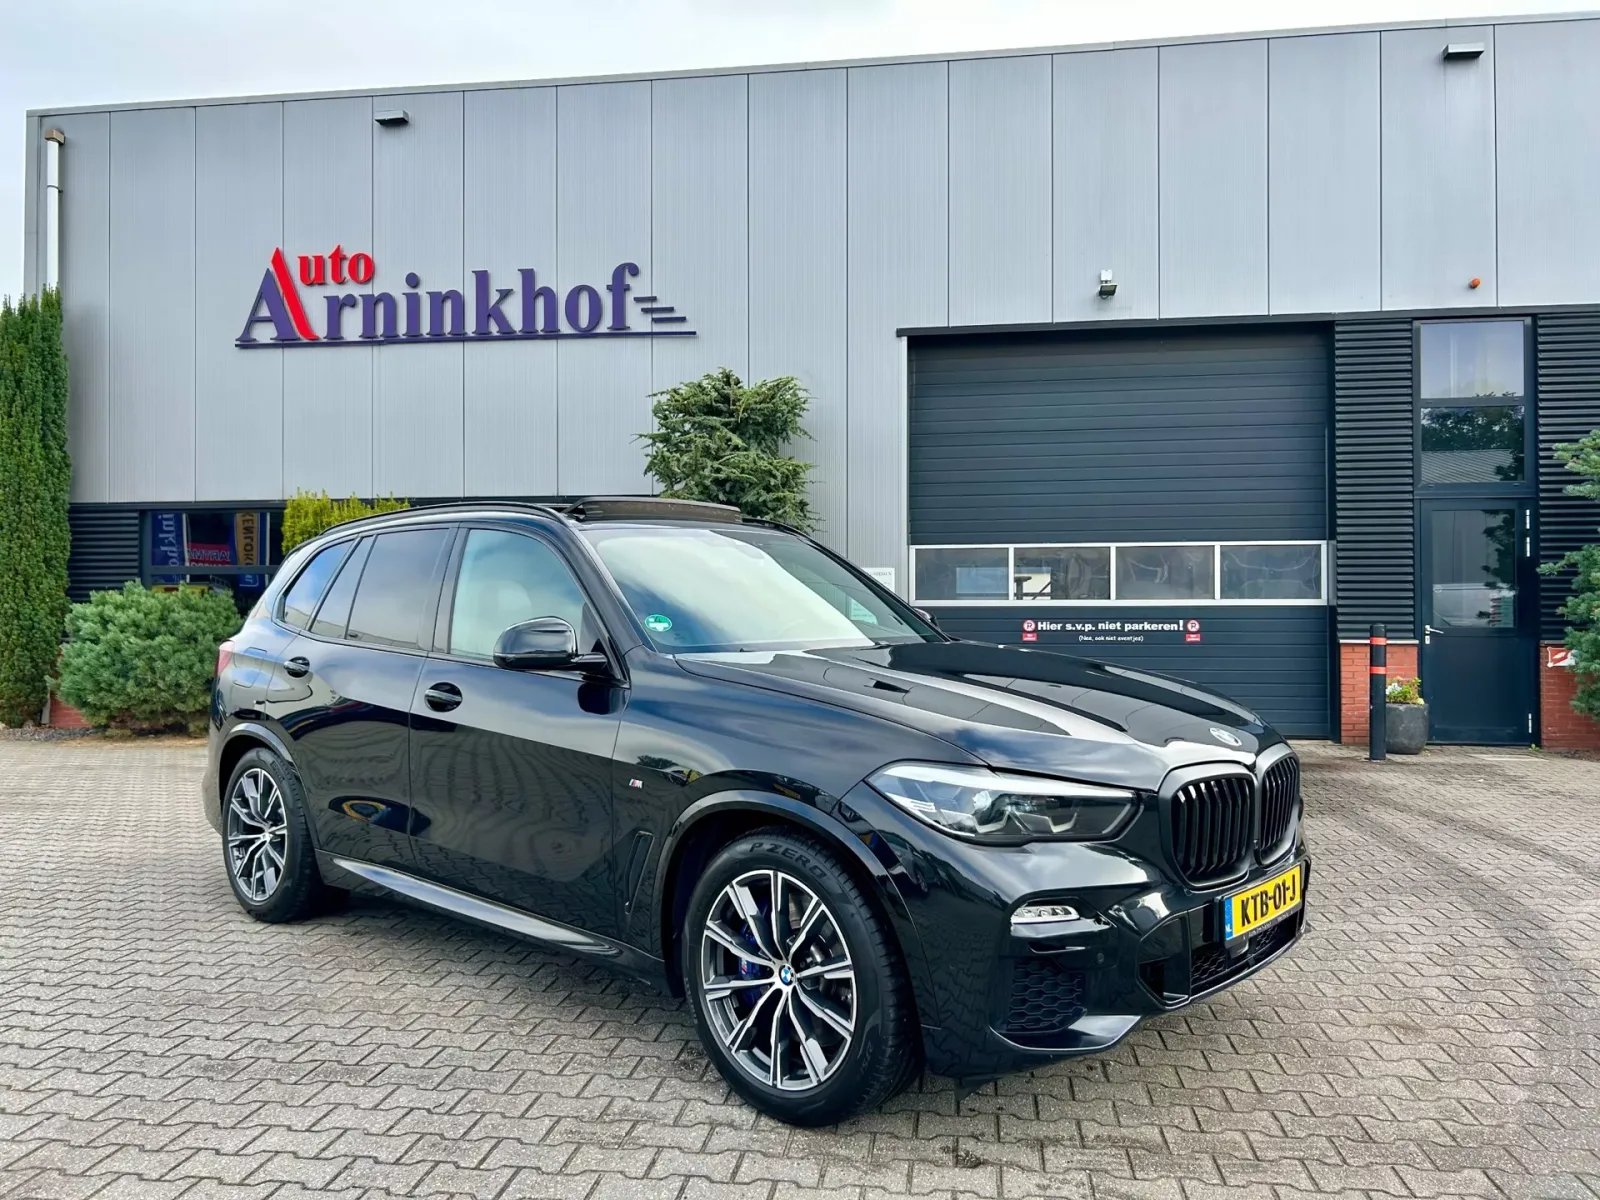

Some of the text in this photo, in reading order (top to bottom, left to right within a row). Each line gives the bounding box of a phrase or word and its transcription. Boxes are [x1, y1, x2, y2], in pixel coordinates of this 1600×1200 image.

[235, 262, 640, 342] Arninkhof
[1037, 619, 1184, 632] Hier s.v.p. niet parkeren!
[749, 842, 827, 879] P ZERO
[1240, 874, 1296, 927] KTB-01-J
